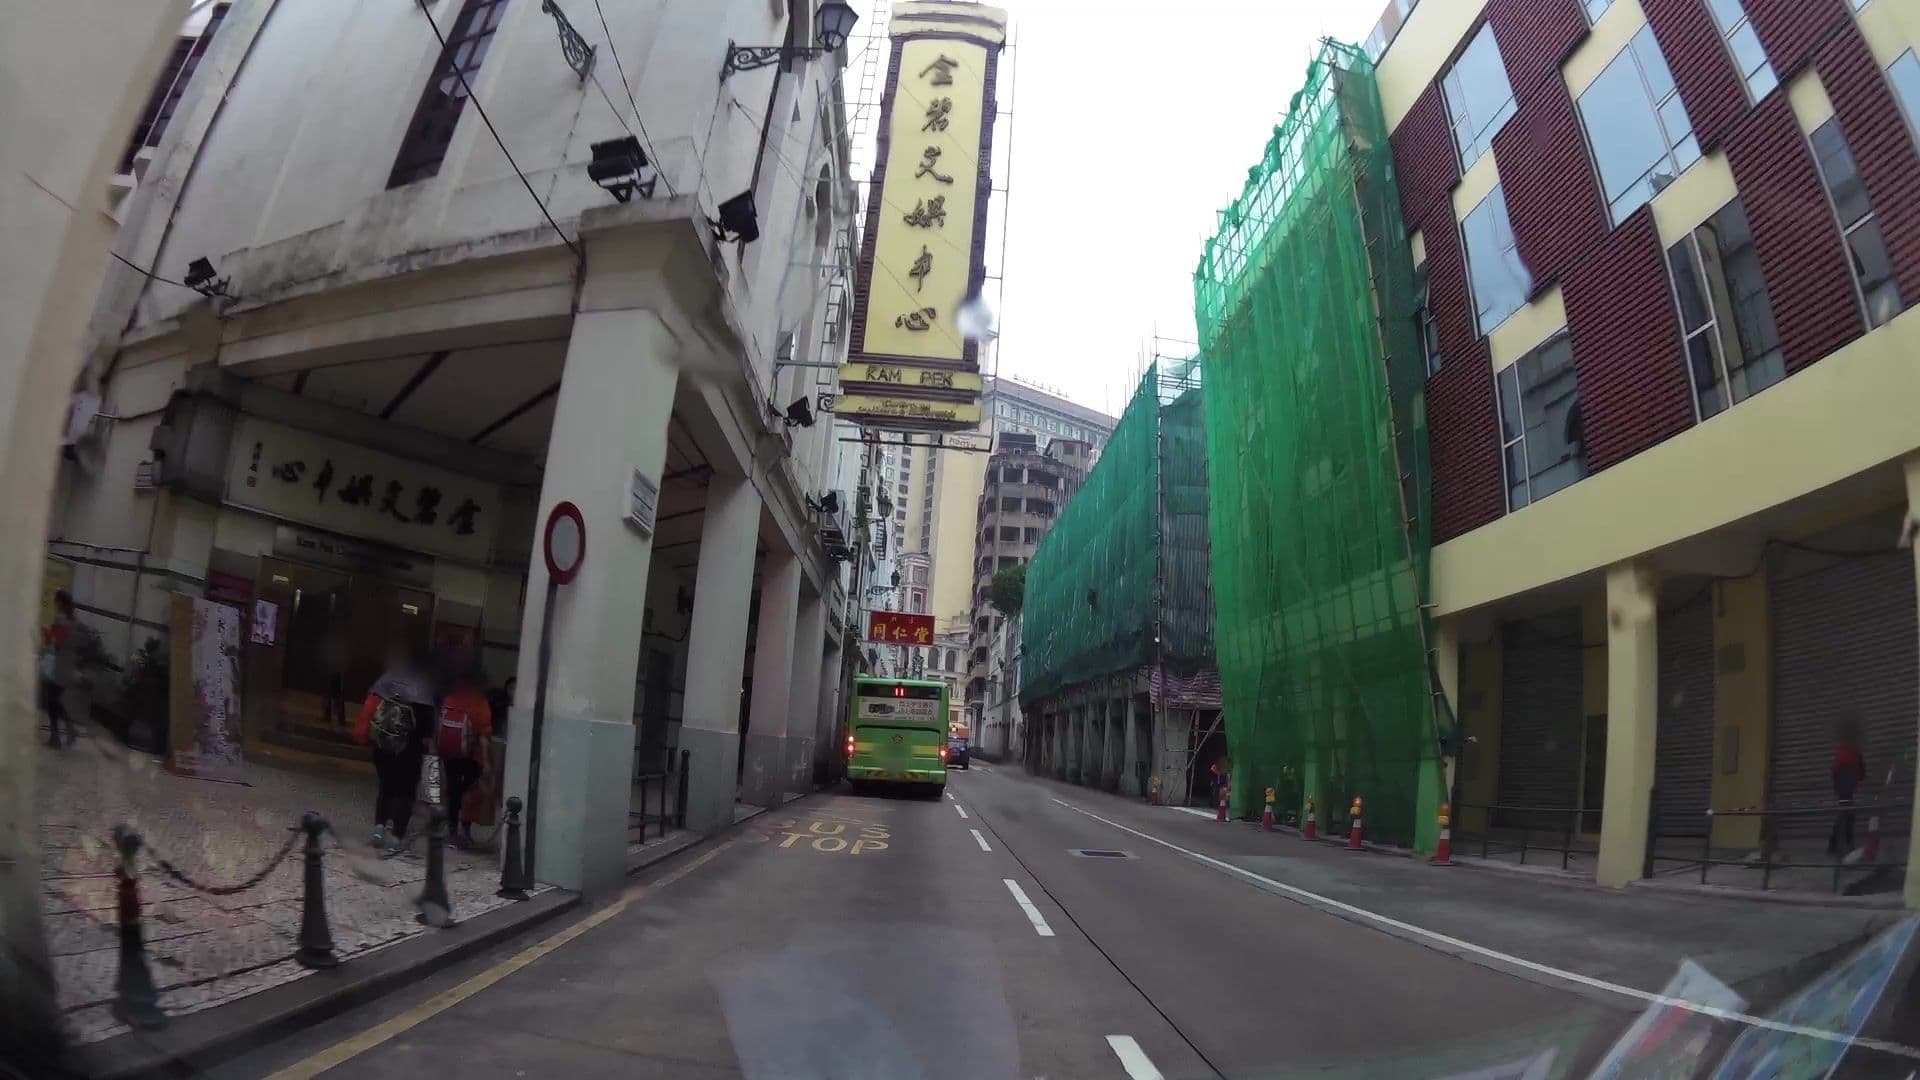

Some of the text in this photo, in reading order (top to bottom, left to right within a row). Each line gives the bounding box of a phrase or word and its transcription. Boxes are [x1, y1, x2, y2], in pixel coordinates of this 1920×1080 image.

[866, 366, 953, 386] KAM PEK
[873, 623, 929, 642] 同仁堂
